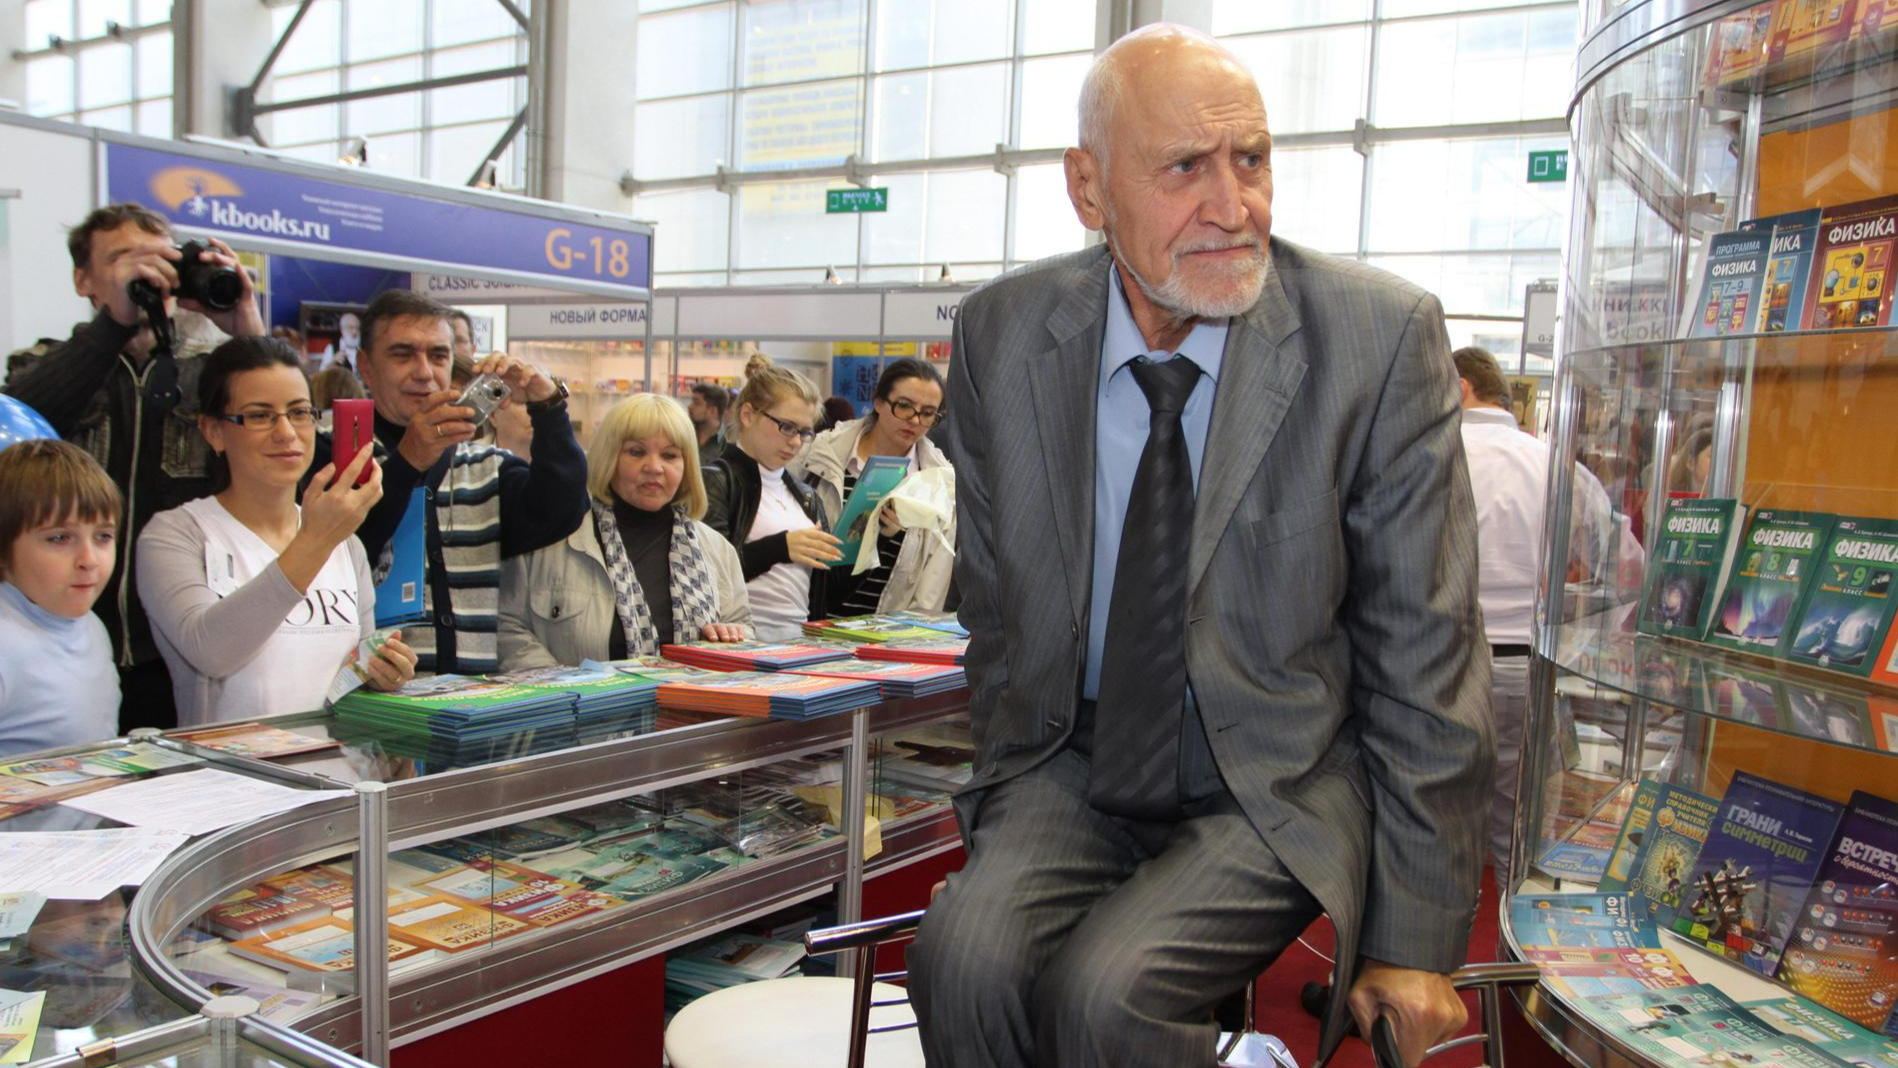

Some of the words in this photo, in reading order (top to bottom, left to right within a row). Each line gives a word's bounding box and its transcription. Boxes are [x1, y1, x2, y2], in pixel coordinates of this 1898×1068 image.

[211, 199, 330, 242] kbooks.ru
[1828, 217, 1895, 244] ФИЗИКА
[545, 227, 629, 278] G-18
[1715, 241, 1760, 256] ПРОГРАММА
[1873, 247, 1882, 262] 7
[1712, 260, 1756, 277] ФИЗИКА
[1782, 260, 1791, 272] 7
[551, 309, 595, 324] НОВЫЙ
[1668, 516, 1719, 534] ФИЗИКА
[1753, 528, 1814, 549] ФИЗИКА
[1682, 539, 1694, 557] 7
[1767, 553, 1781, 571] 8
[1851, 566, 1866, 586] 9
[1843, 588, 1862, 596] КЛАСС
[1666, 798, 1709, 819] СПРАВОЧНИК
[1726, 804, 1783, 837] ГРАНИ
